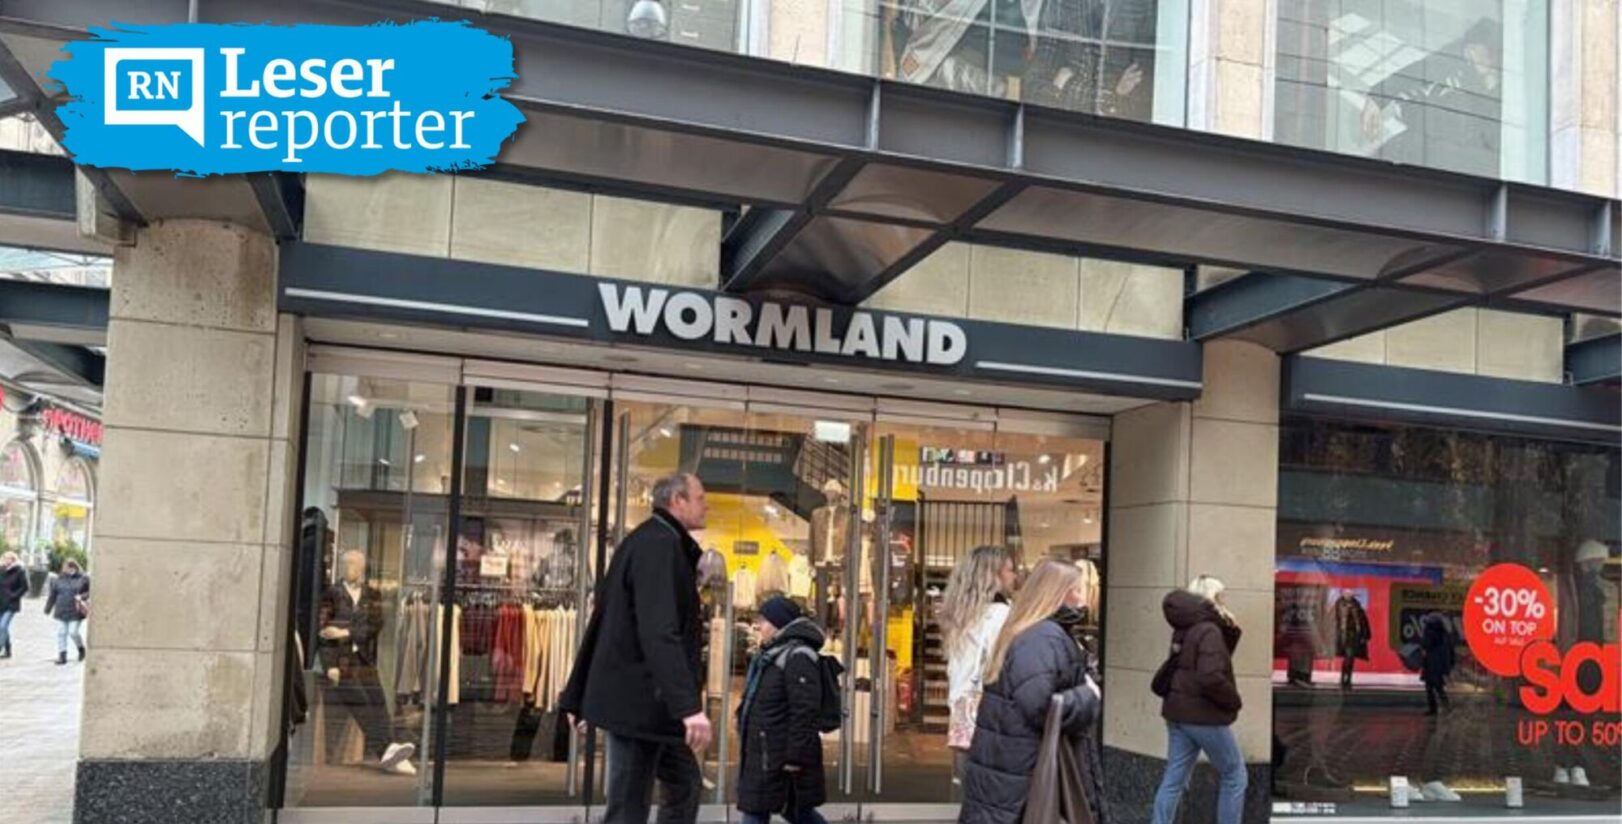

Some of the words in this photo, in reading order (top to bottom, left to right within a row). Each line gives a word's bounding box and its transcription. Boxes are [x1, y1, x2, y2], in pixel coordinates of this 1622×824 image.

[598, 283, 967, 365] WORMLAND
[1474, 588, 1545, 619] -30%
[1482, 619, 1505, 634] ON
[1510, 620, 1537, 637] TOP
[1520, 612, 1622, 715] sa
[1518, 720, 1548, 746] UP
[1555, 720, 1585, 746] TO
